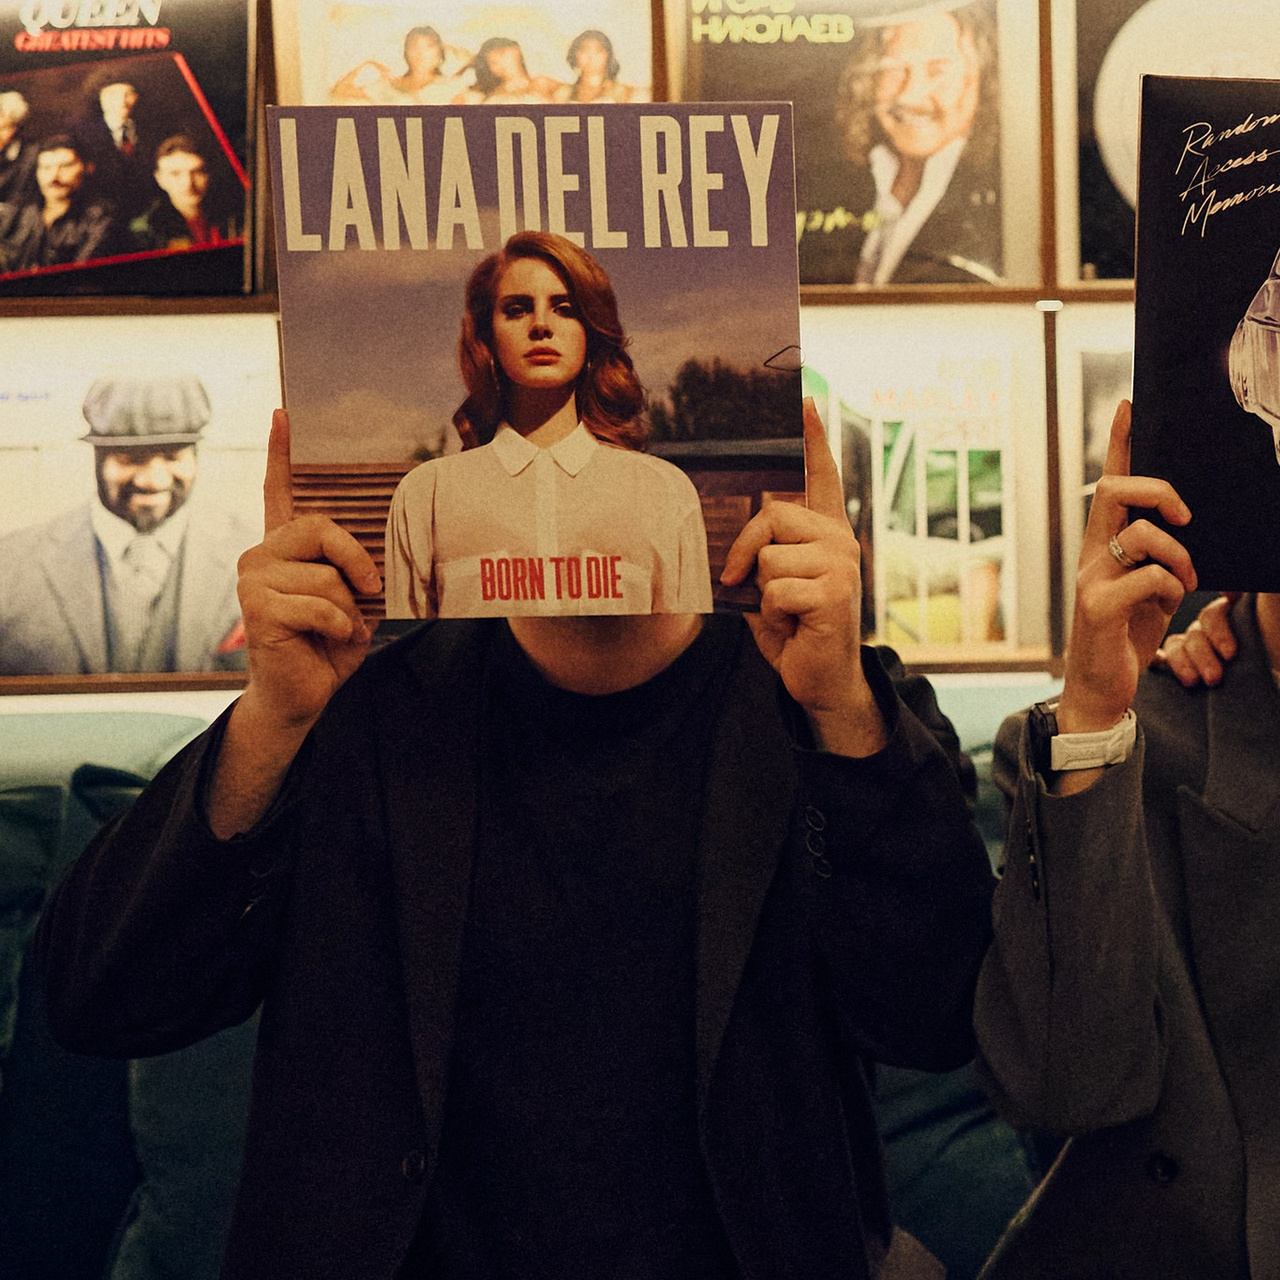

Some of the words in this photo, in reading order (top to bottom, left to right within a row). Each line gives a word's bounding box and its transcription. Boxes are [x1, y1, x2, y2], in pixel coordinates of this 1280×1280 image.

[691, 13, 855, 44] НИКОЛАЕВ
[279, 116, 484, 251] LANA
[495, 116, 628, 248] DEL
[639, 115, 780, 248] REY
[480, 557, 545, 601] BORN
[549, 556, 582, 600] TO
[586, 555, 624, 599] DIE
